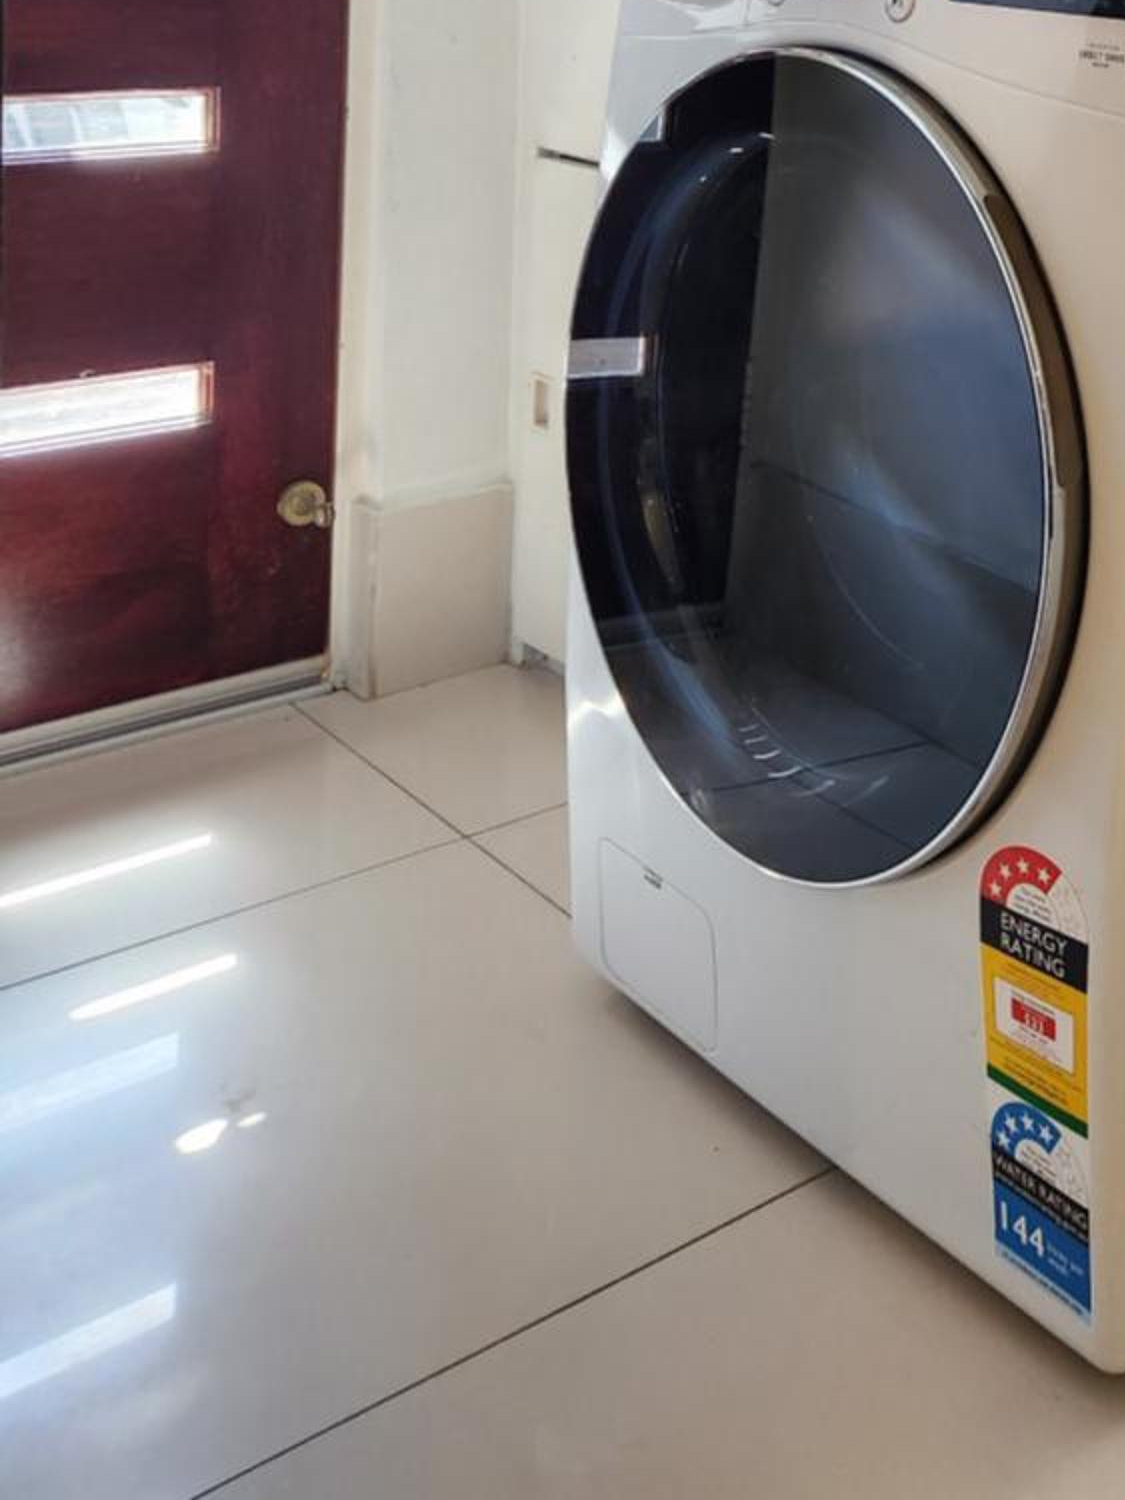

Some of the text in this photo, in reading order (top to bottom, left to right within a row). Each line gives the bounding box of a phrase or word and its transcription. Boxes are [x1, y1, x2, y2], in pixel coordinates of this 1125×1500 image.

[1000, 910, 1069, 957] ENERGY
[1000, 931, 1066, 978] RATING
[1001, 1200, 1045, 1258] 144
